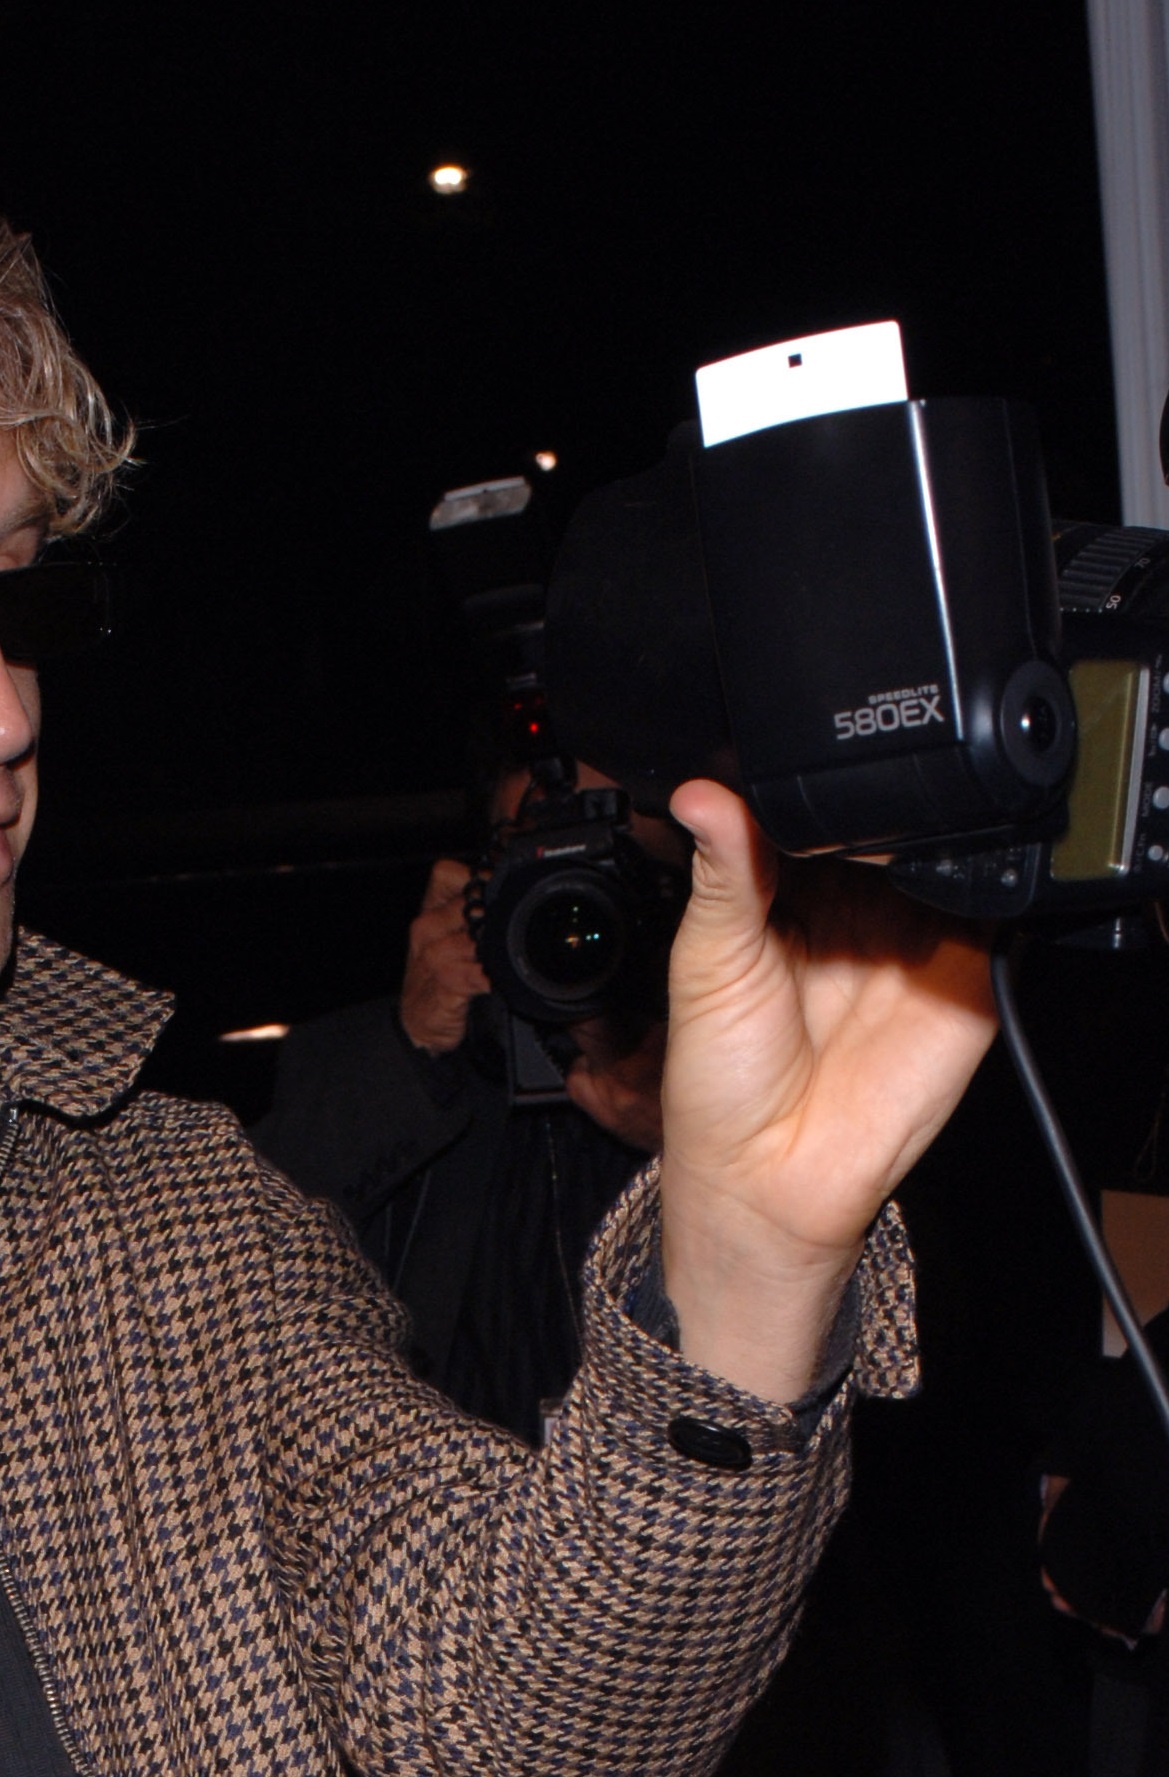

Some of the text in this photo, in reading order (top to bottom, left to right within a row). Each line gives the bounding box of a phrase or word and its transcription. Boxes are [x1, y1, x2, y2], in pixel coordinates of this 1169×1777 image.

[1105, 595, 1122, 610] 50
[868, 684, 938, 704] SPEEDLITE
[834, 695, 944, 740] 580EX
